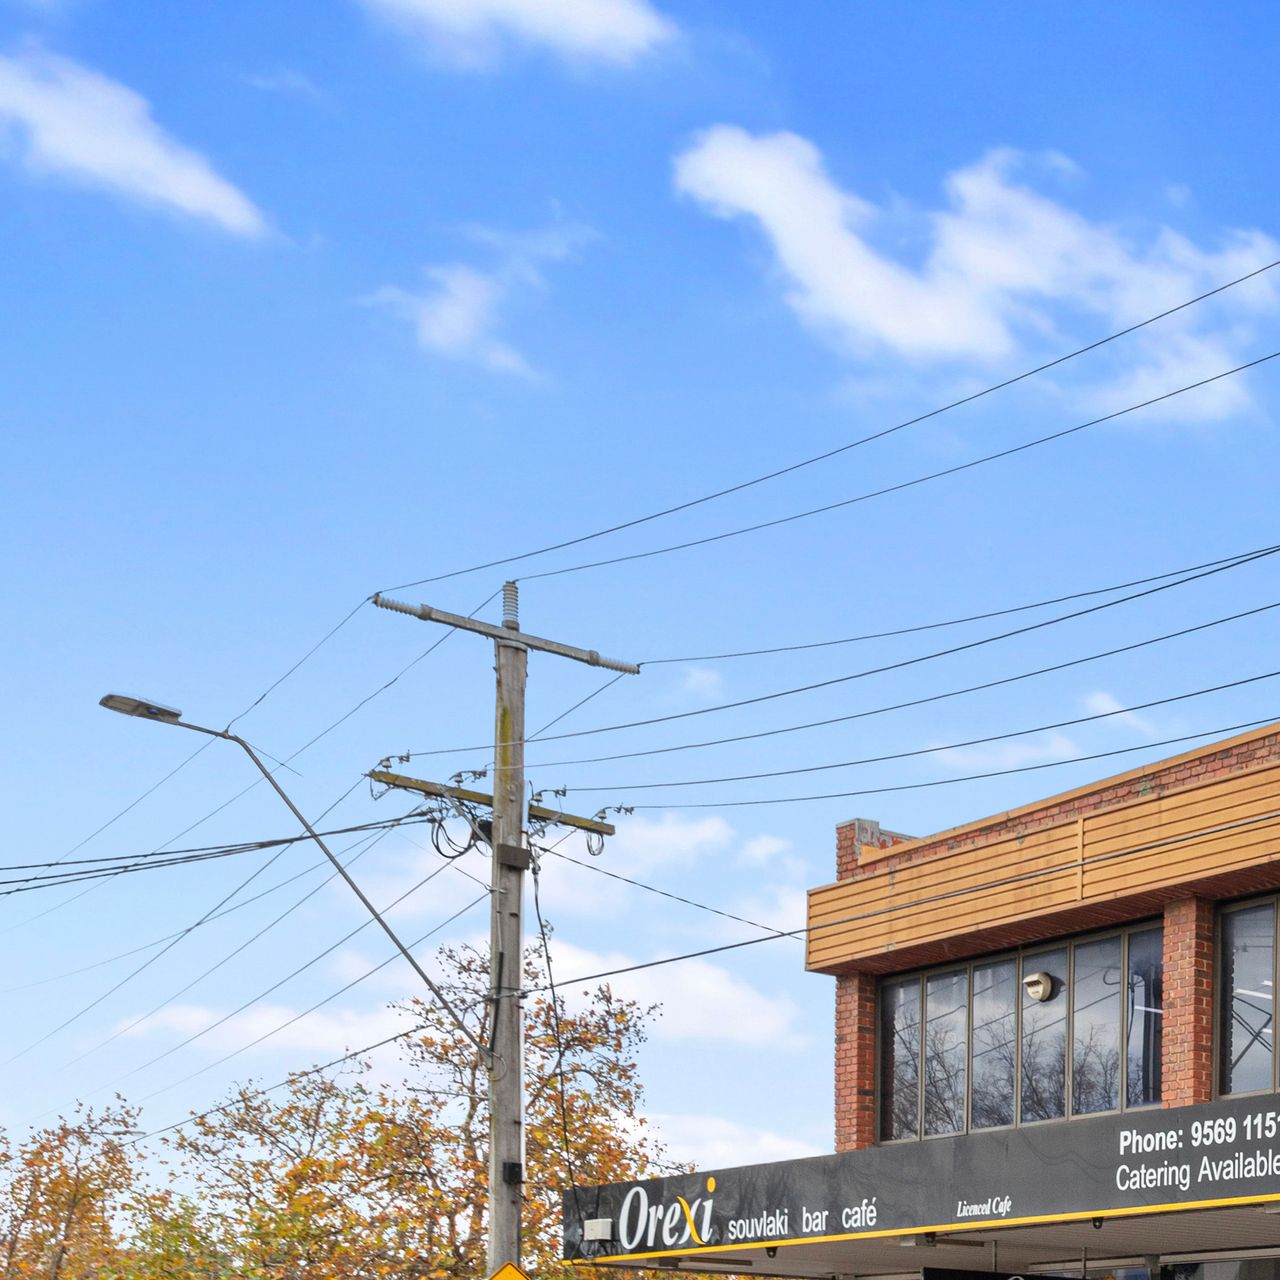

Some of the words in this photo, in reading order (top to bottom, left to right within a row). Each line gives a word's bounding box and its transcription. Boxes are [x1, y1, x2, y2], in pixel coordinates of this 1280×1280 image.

[1119, 1129, 1183, 1155] Phone:
[1191, 1117, 1237, 1147] 9569
[1116, 1160, 1190, 1191] Catering
[619, 1176, 717, 1250] Orexi
[728, 1208, 788, 1240] souvlaki
[802, 1206, 829, 1233] bar
[842, 1197, 877, 1229] café
[957, 1198, 991, 1217] Licenced
[992, 1195, 1012, 1216] Cafe
